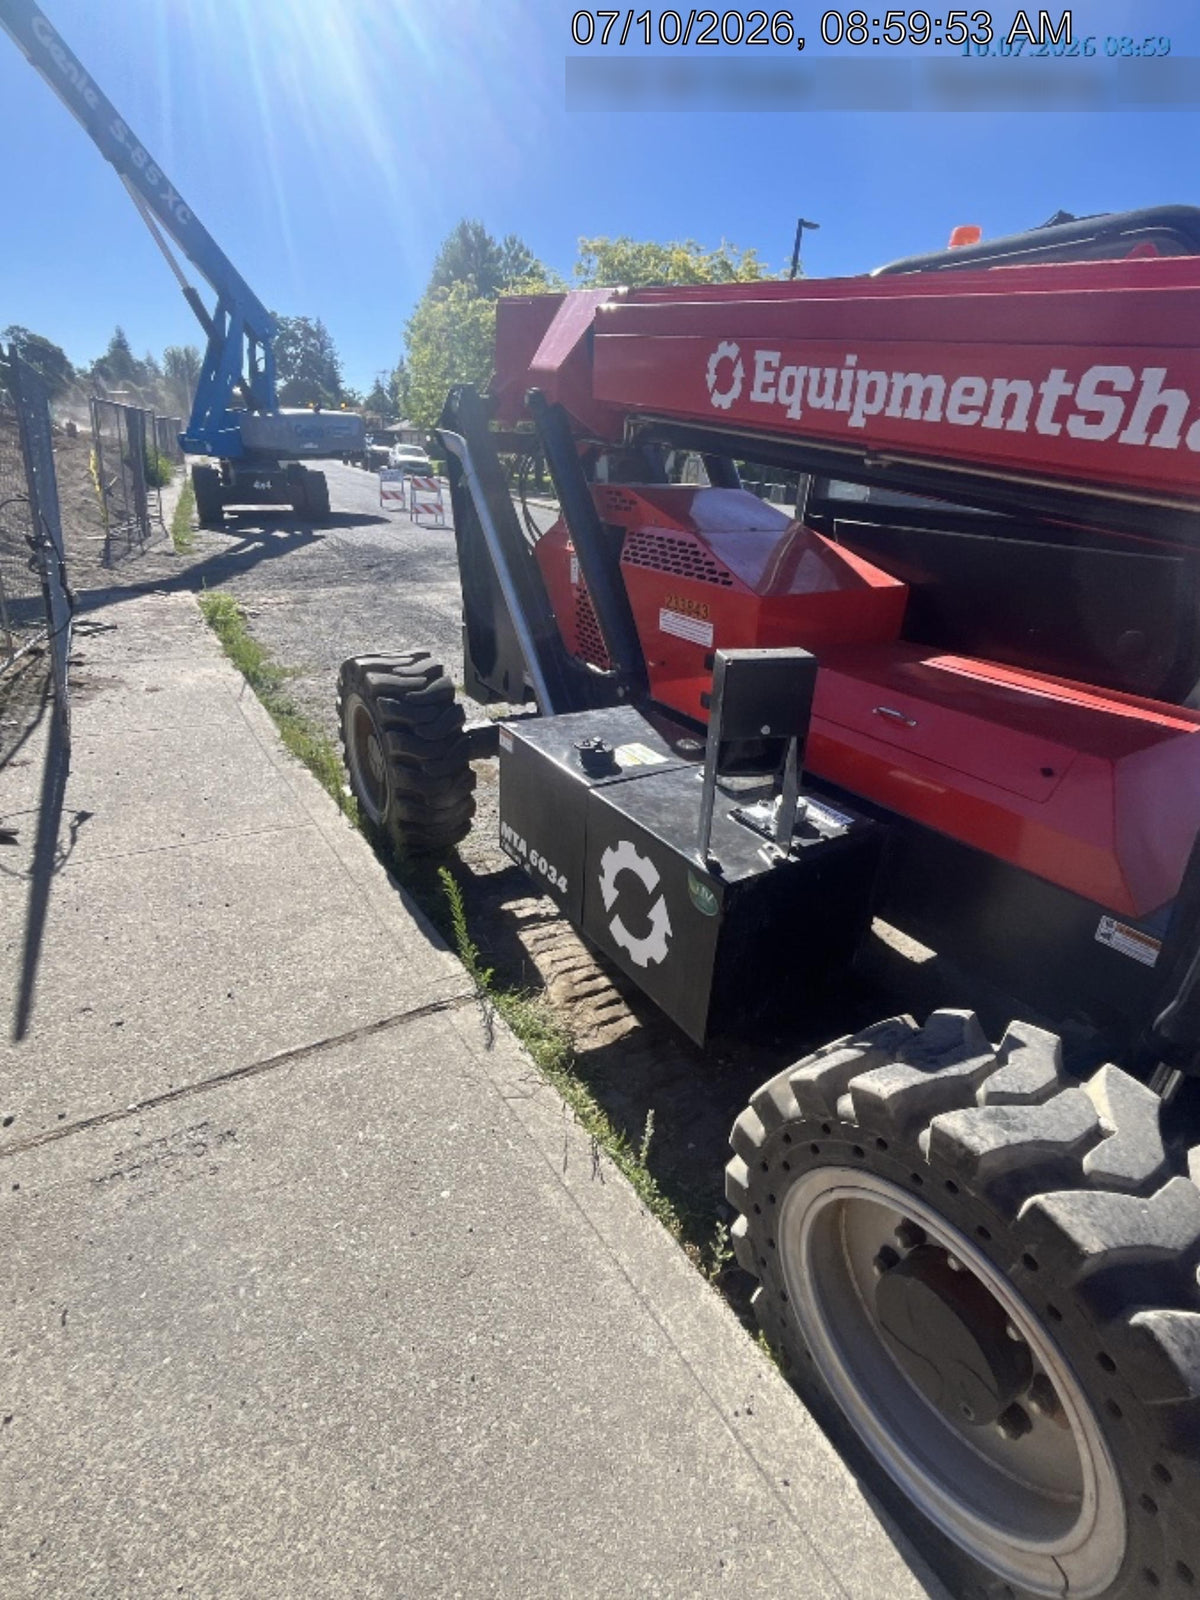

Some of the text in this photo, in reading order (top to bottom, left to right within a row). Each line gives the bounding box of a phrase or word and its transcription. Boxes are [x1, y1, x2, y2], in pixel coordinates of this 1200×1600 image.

[31, 15, 99, 111] Genie
[159, 186, 192, 226] XC
[501, 821, 527, 858] MTA
[529, 849, 568, 893] 6034
